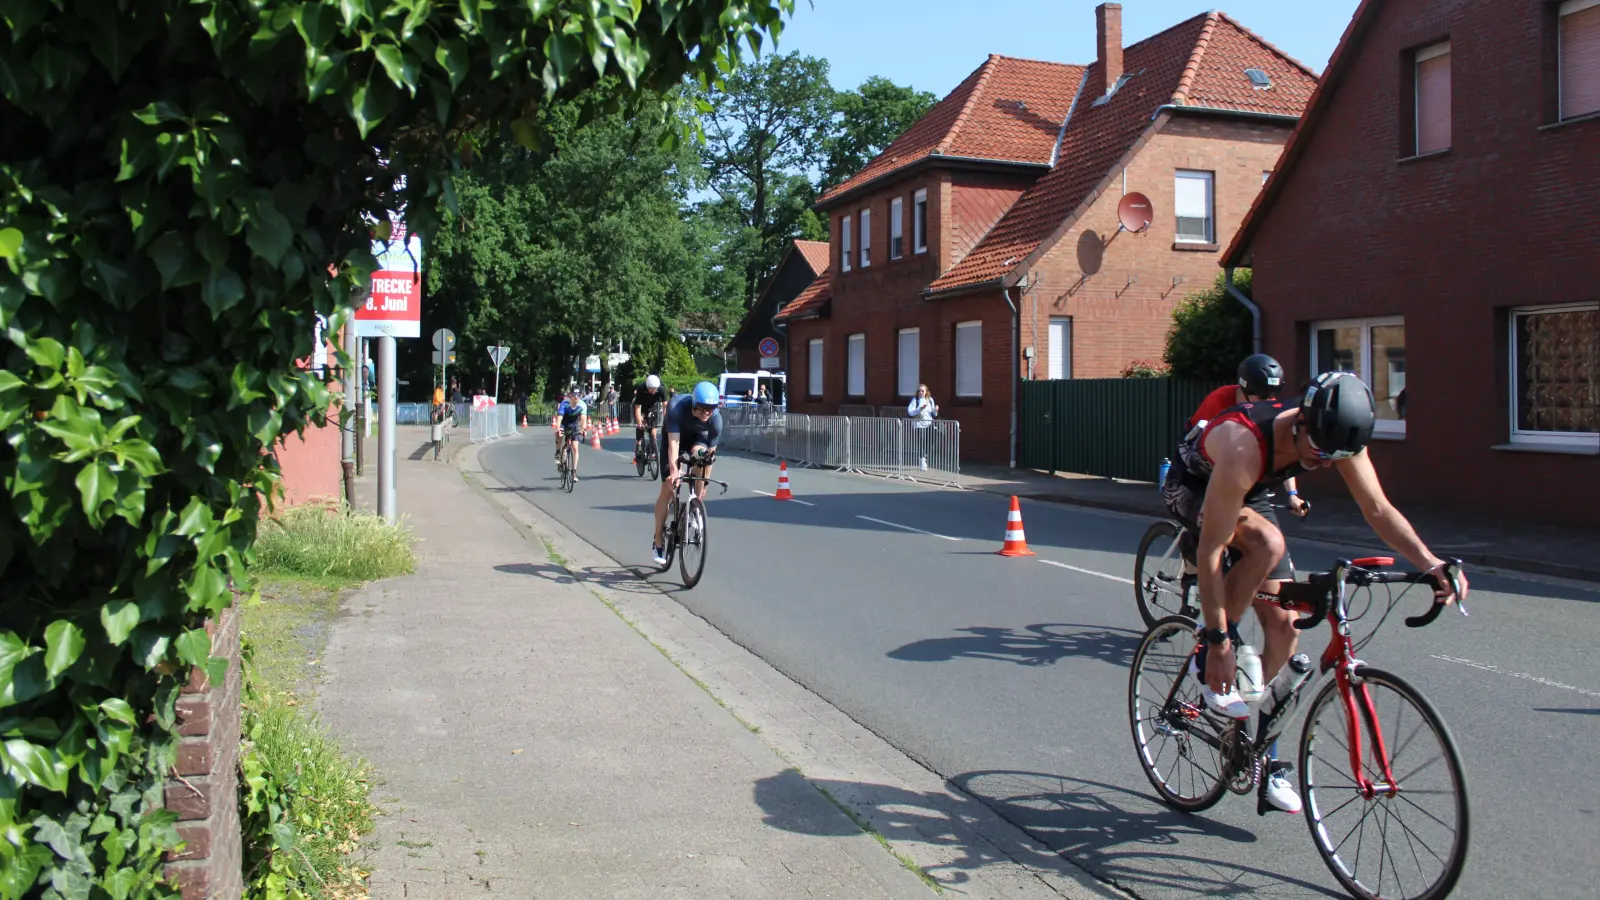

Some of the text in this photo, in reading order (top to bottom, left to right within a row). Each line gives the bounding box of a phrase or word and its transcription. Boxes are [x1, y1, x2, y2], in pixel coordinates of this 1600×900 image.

[372, 278, 412, 295] TRECKE
[366, 296, 408, 311] 8. Juni
